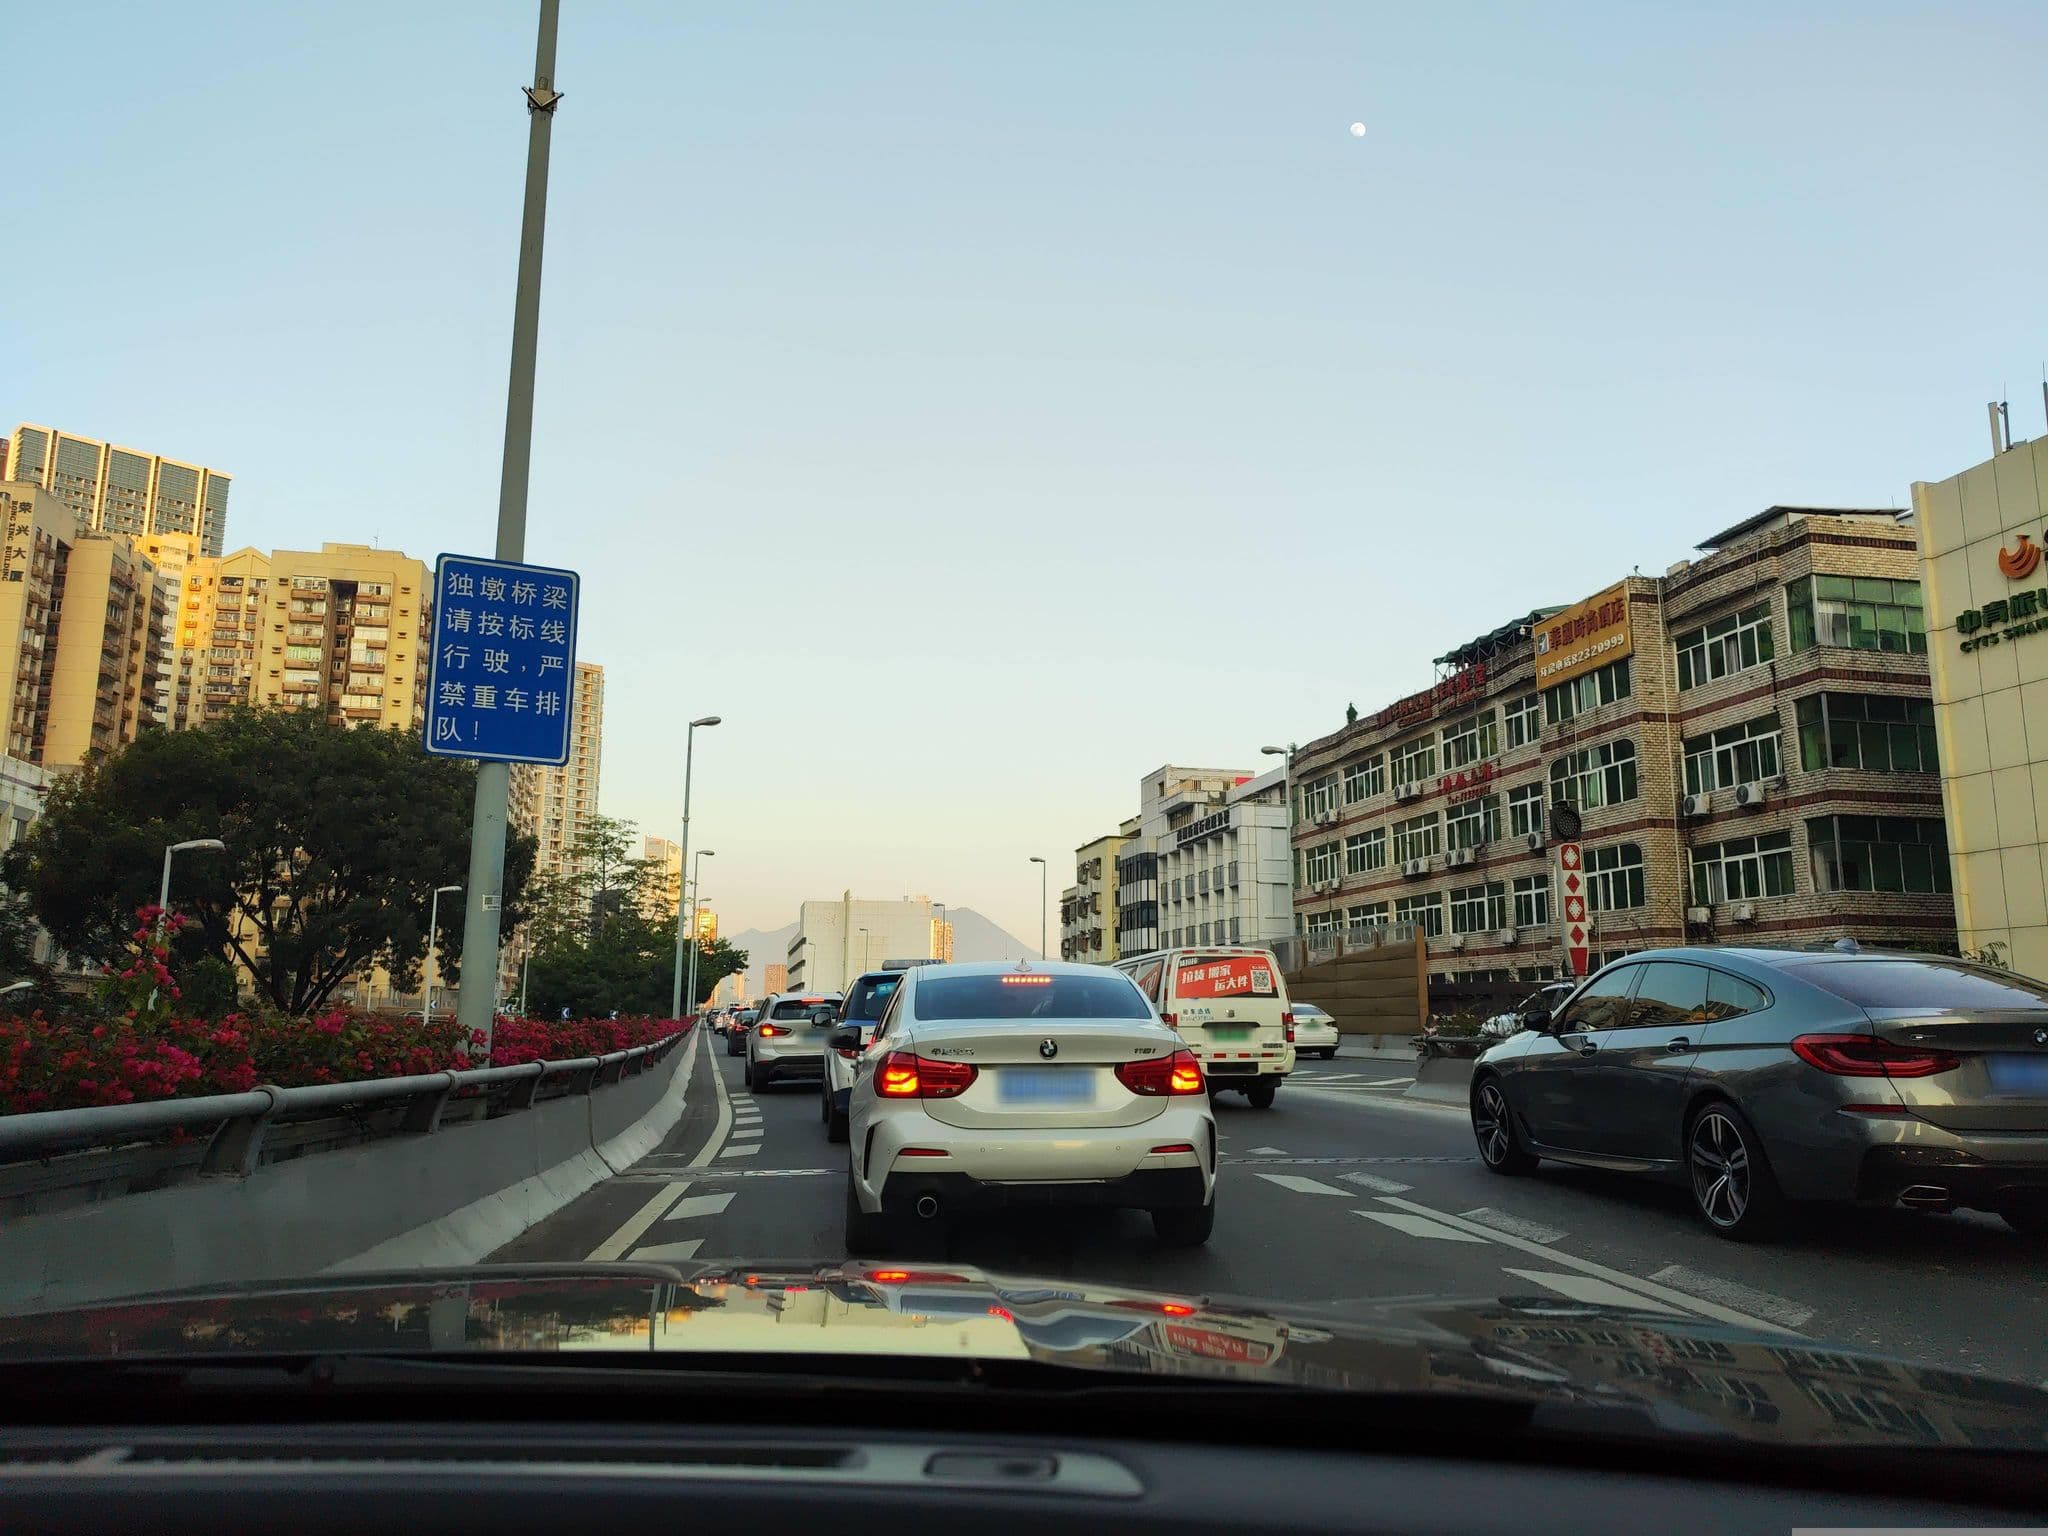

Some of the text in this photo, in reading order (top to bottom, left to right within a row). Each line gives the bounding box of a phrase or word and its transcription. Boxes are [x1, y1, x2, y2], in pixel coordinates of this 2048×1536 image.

[9, 502, 33, 582] 荣兴大厦
[2, 546, 13, 582] BUILDING
[448, 572, 568, 610] 独墩桥梁
[445, 607, 566, 645] 请按标线
[439, 681, 561, 716] 禁重车排
[1182, 965, 1231, 984] 拉货 搬家
[1214, 975, 1249, 992] 运大件
